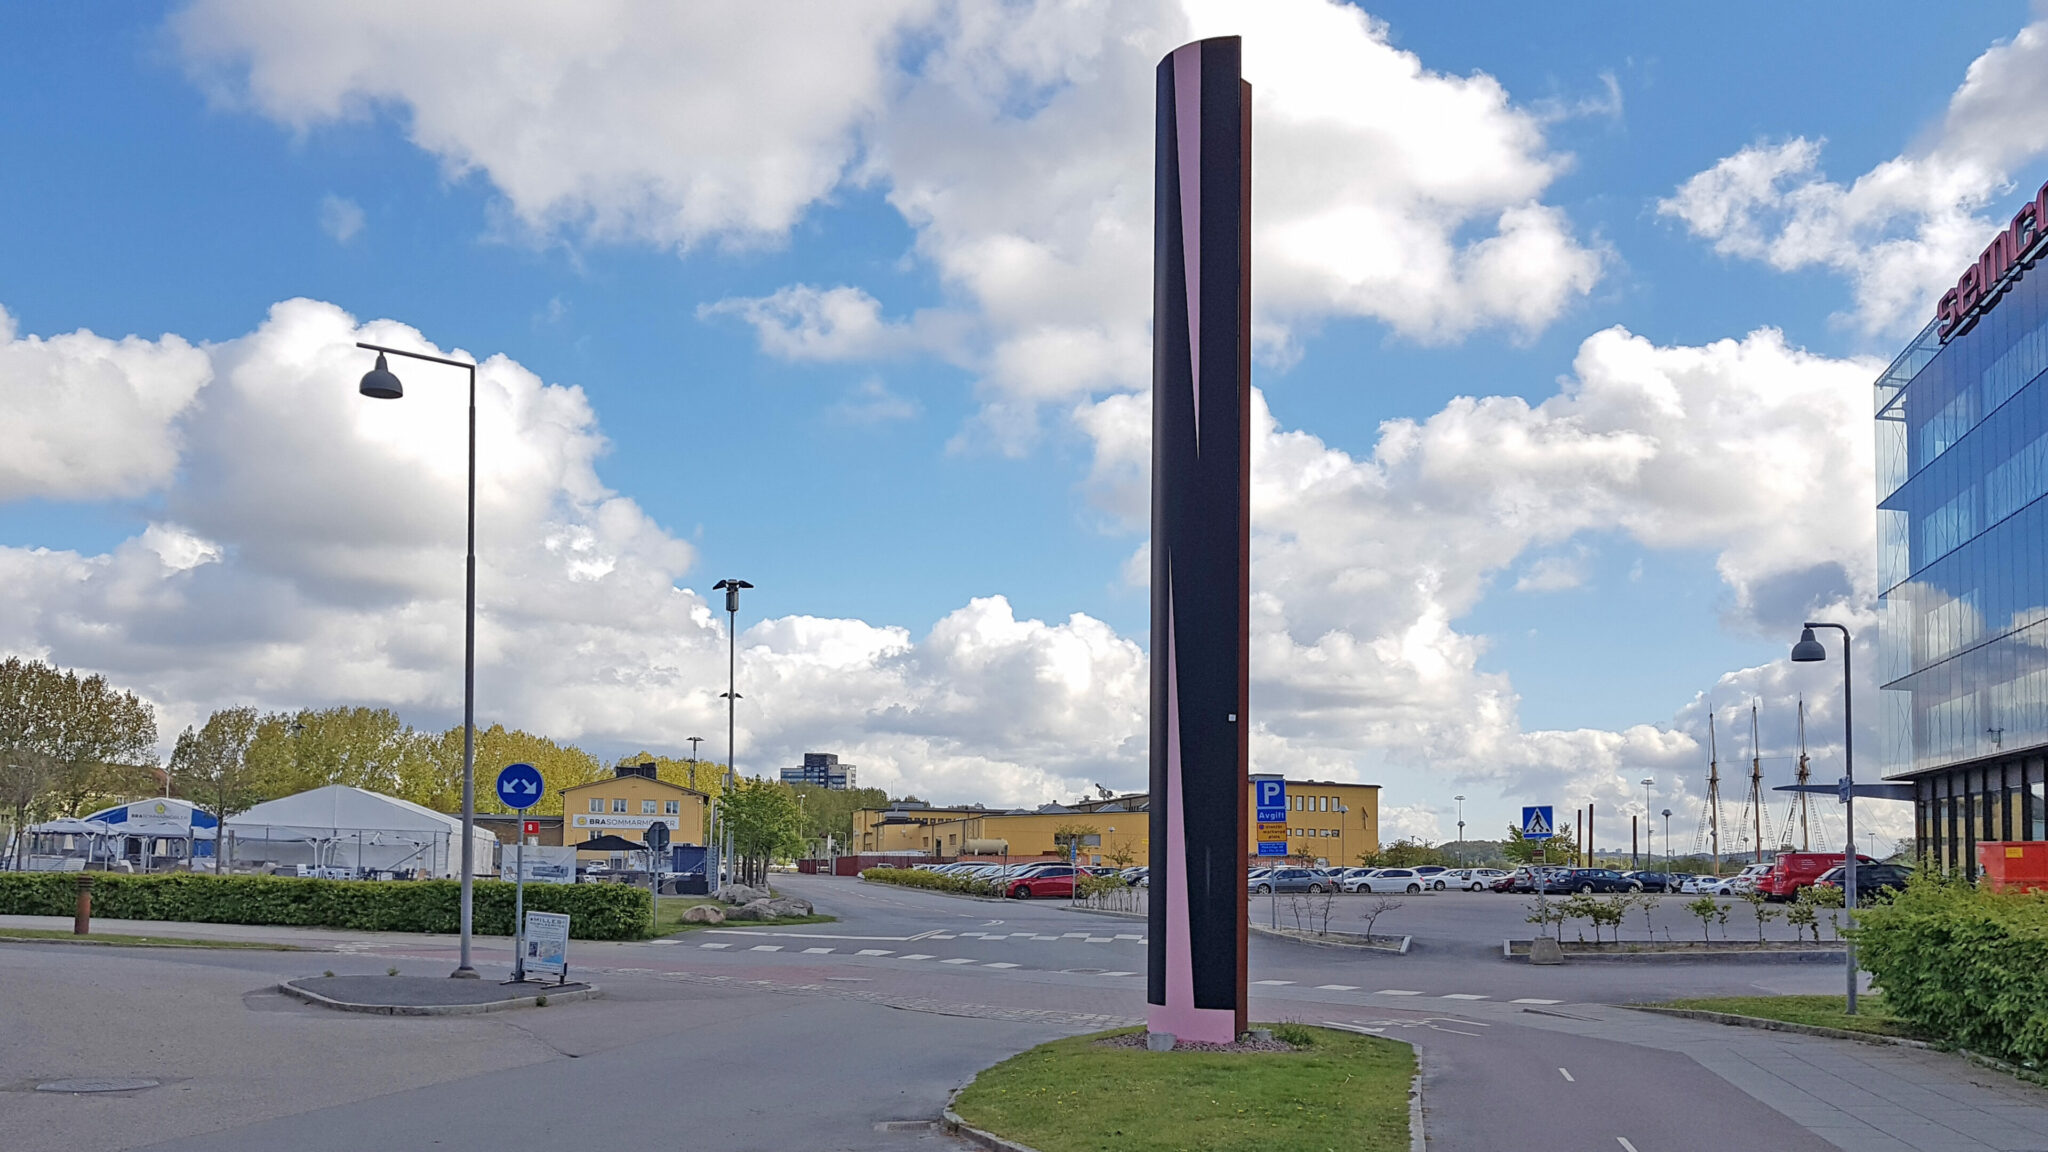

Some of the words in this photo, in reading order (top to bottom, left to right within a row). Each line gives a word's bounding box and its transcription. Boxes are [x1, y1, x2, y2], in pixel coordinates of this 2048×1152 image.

[1263, 782, 1281, 805] P
[1259, 812, 1284, 820] Avgift
[589, 818, 676, 827] BRASOMMARMÖER
